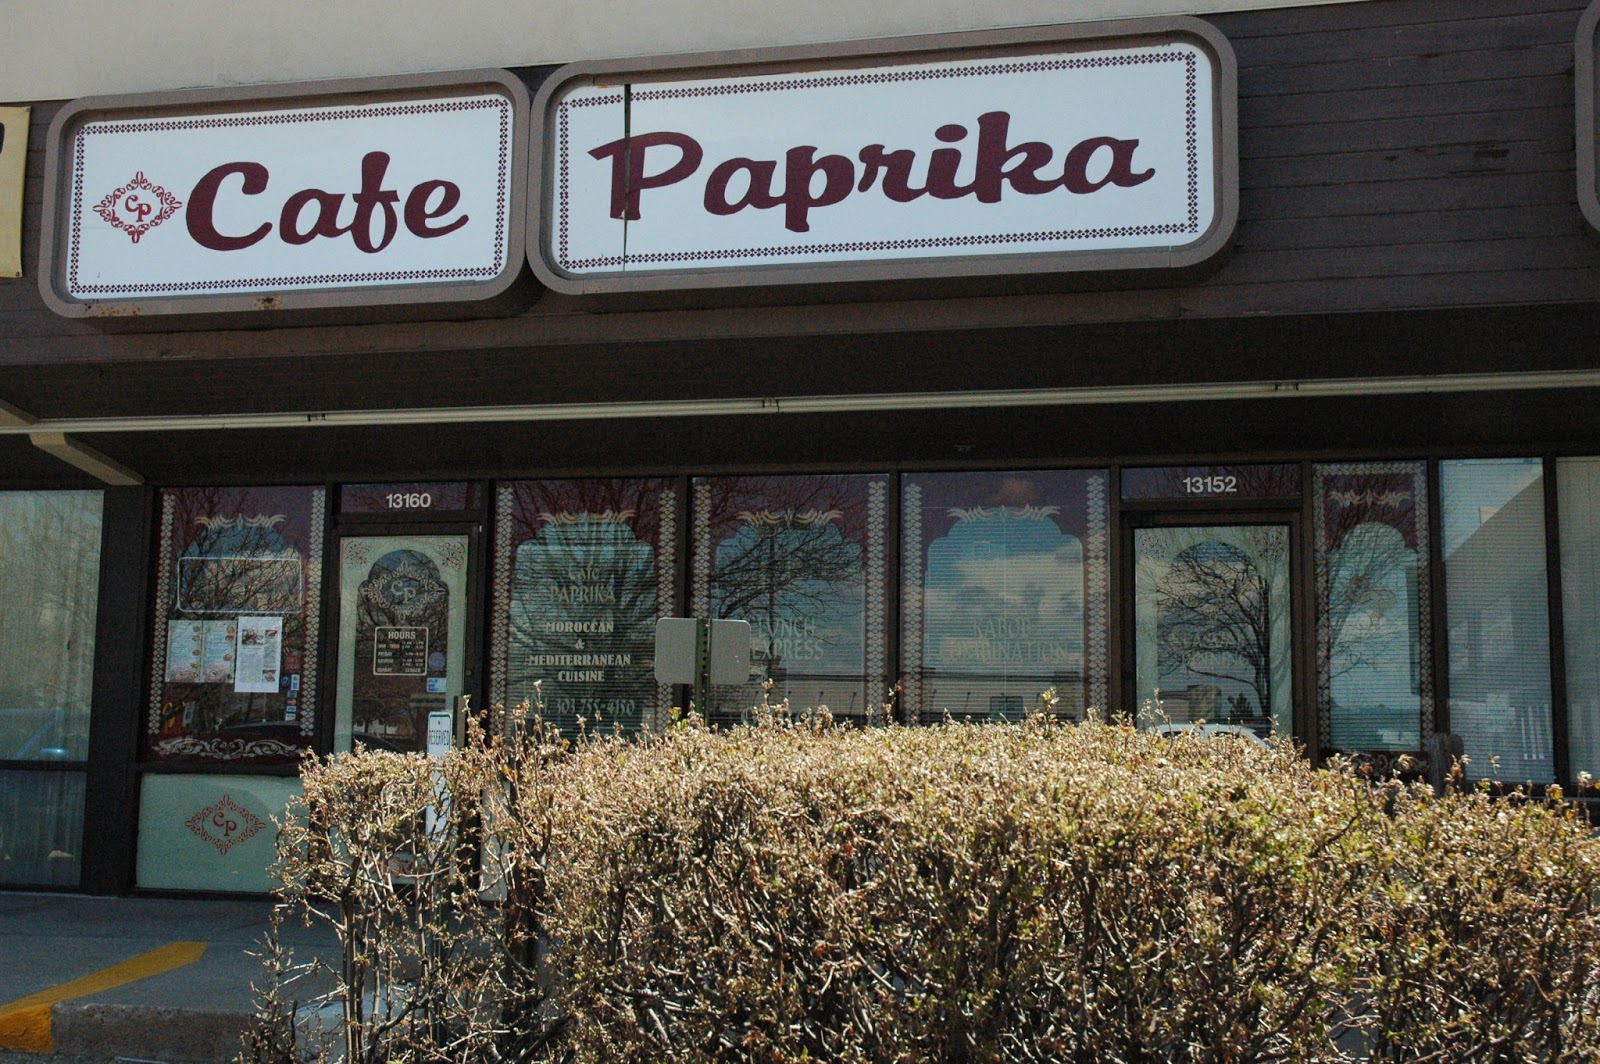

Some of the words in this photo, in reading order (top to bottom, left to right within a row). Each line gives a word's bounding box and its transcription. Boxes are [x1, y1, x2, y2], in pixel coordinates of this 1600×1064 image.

[185, 150, 469, 254] Cafe
[587, 111, 1156, 233] Paprika
[1183, 476, 1237, 494] 13152
[386, 493, 431, 508] 13160
[549, 585, 616, 604] PAPRIKA
[545, 621, 614, 633] MOROCCAN
[388, 631, 416, 640] HOURS
[575, 639, 585, 650] &
[751, 638, 825, 661] EXPRESS
[528, 654, 631, 666] MEDITERRANEAN
[557, 670, 605, 682] CUISINE
[428, 730, 449, 745] RESERVED
